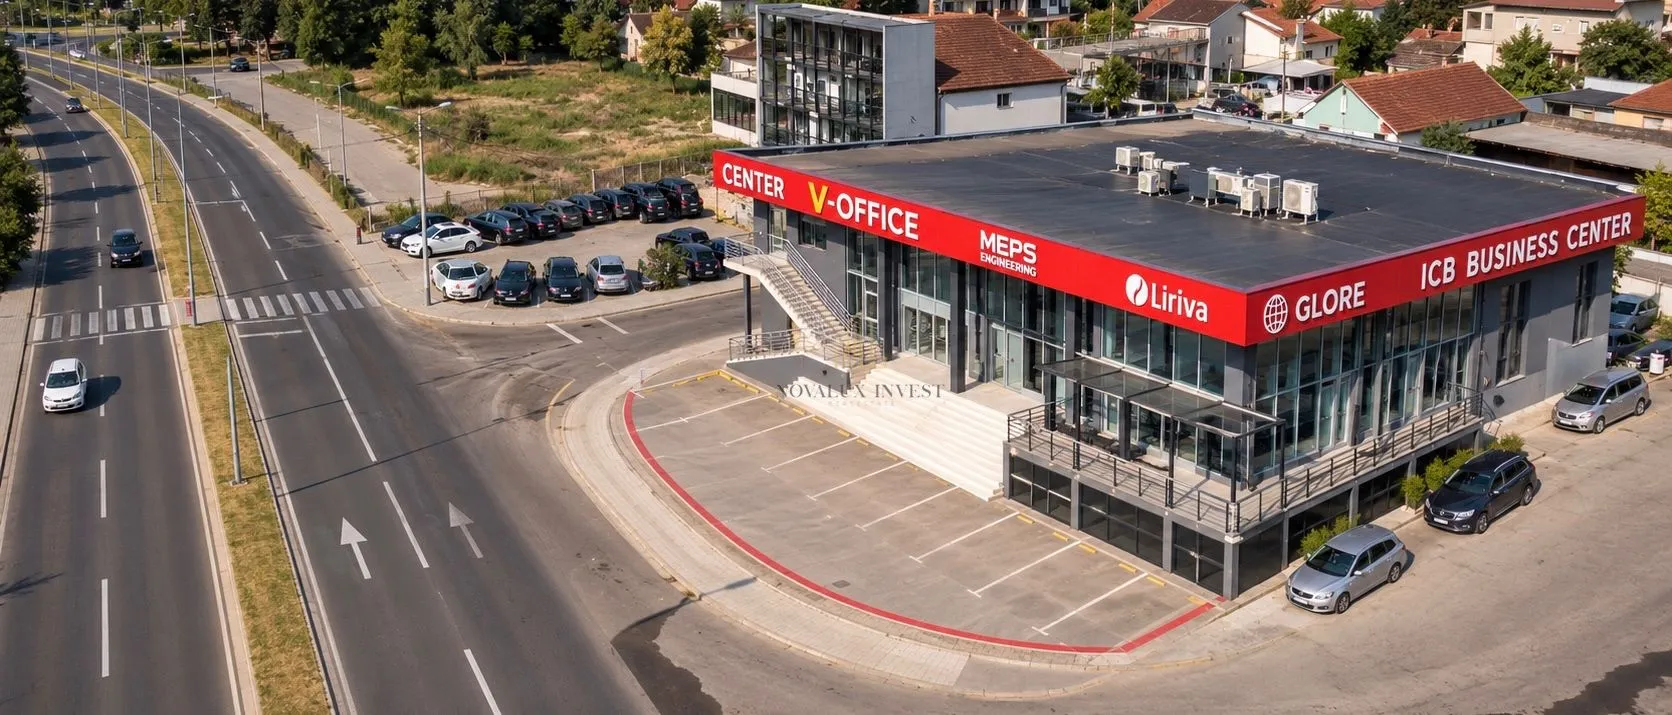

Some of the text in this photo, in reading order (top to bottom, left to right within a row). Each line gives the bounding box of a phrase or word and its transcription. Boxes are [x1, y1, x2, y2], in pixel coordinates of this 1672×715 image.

[722, 162, 785, 200] CENTER
[808, 181, 919, 241] V-OFFICE
[979, 229, 1037, 264] MEPS
[980, 252, 1037, 278] ENGINEERING
[1421, 212, 1632, 290] ICB BUSINESS CENTER
[1151, 281, 1208, 323] Liriva
[1295, 281, 1366, 322] GLORE
